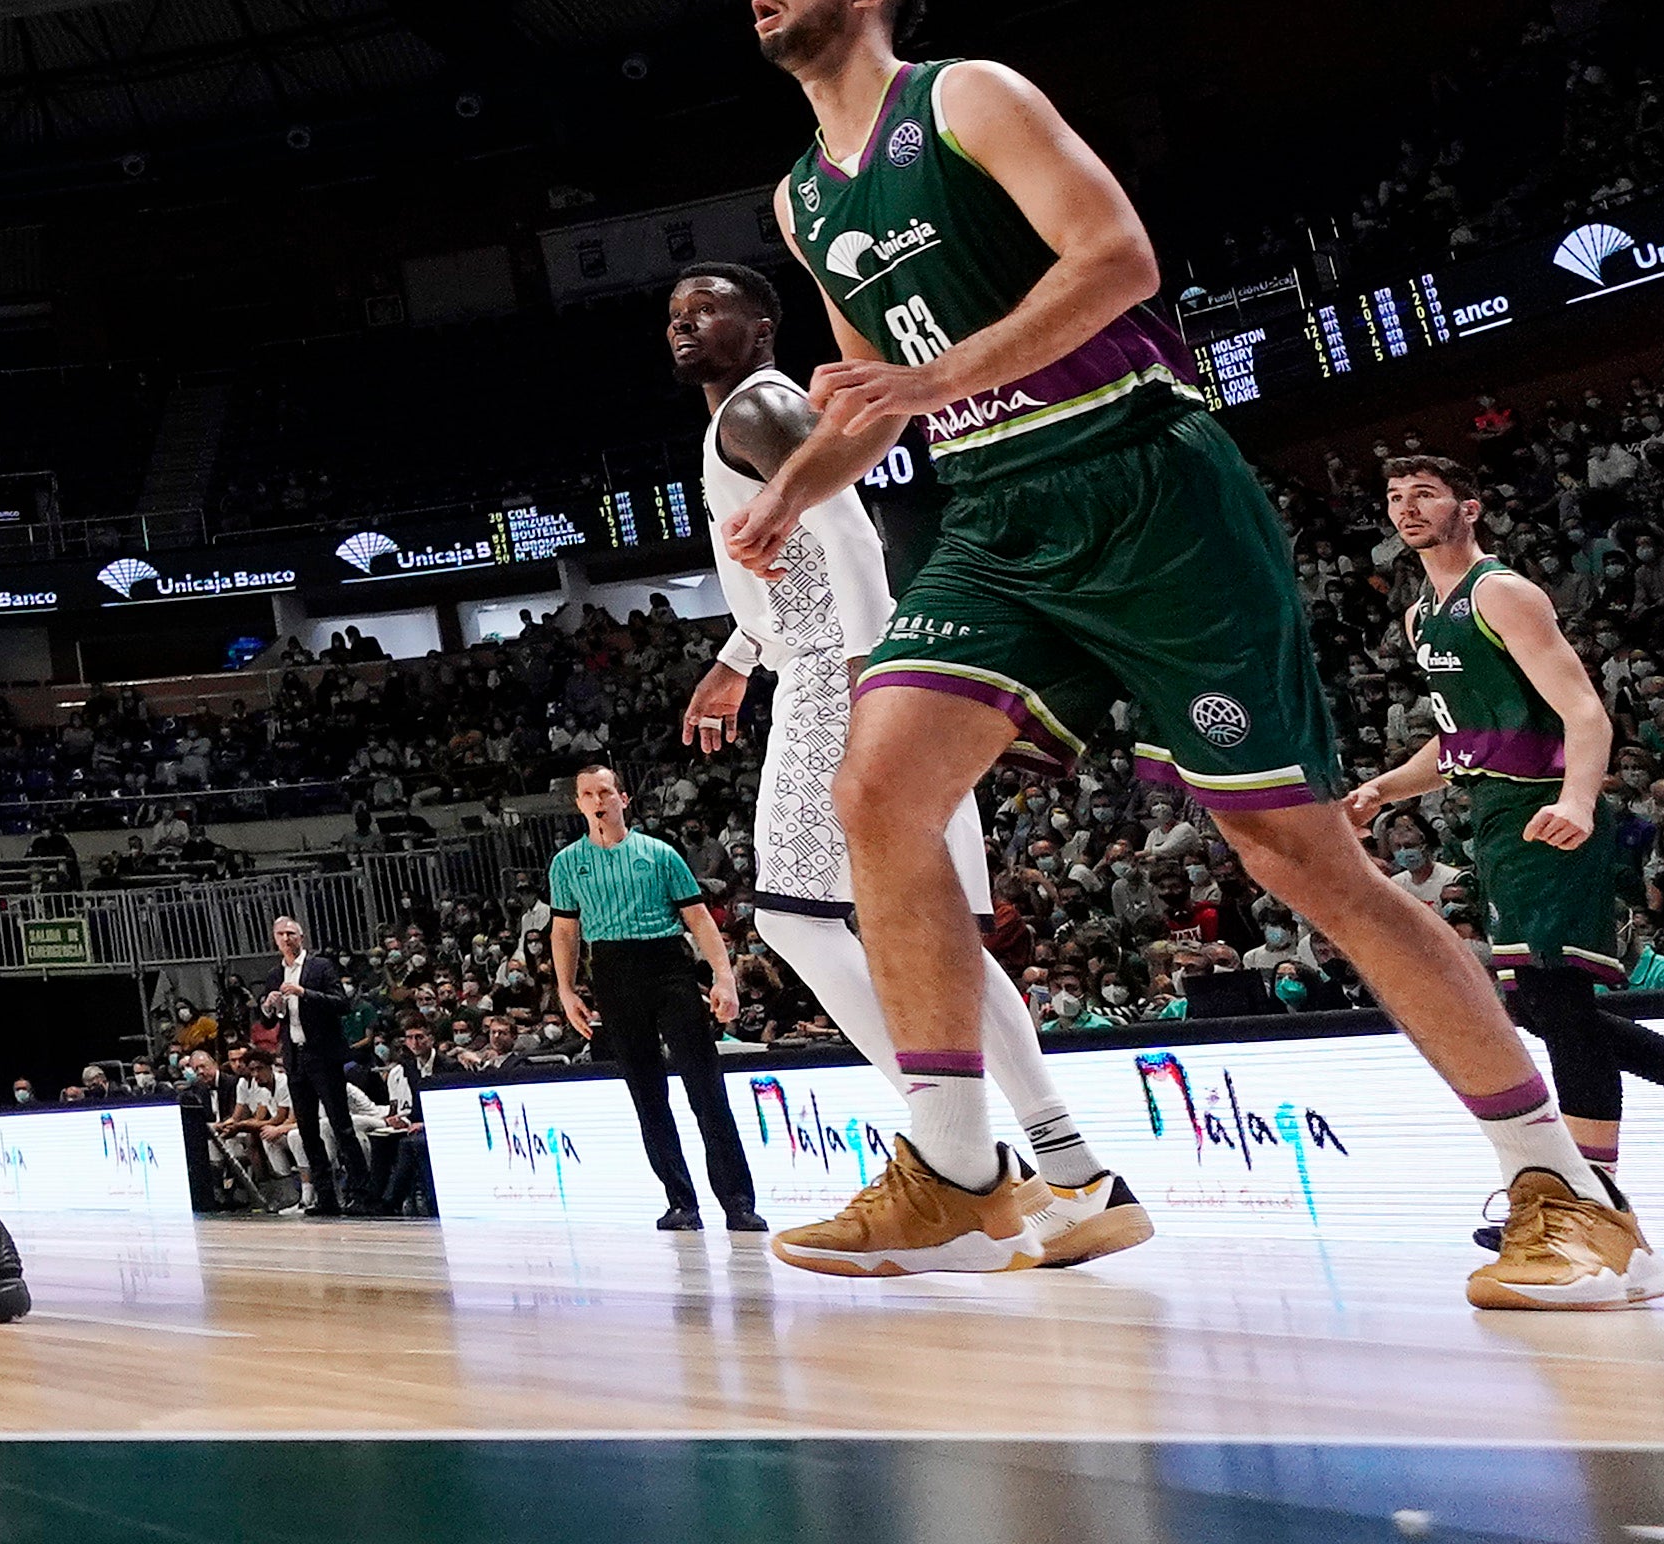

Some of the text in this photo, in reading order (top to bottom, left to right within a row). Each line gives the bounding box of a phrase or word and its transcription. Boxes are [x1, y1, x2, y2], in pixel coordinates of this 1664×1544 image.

[872, 218, 936, 261] Unicaja
[1453, 295, 1509, 326] anco
[885, 294, 955, 367] 83
[1194, 346, 1208, 360] 11
[1210, 328, 1266, 355] HOLSTON
[1197, 359, 1212, 373] 22
[1214, 345, 1254, 368] HENRY
[1304, 325, 1319, 340] 12
[1217, 359, 1255, 382] KELLY
[1203, 385, 1218, 399] 21
[1221, 375, 1256, 395] LOUM
[1207, 397, 1222, 412] 20
[1224, 386, 1261, 407] WARE
[864, 444, 914, 488] 40
[507, 506, 538, 520] COLE
[509, 513, 568, 531] BRIZUELA
[511, 522, 575, 542] BOUTEILLE
[513, 532, 586, 553] ABROMAITIS
[395, 542, 474, 570] Unicaja
[156, 567, 296, 595] Unicaja Banco
[1134, 1052, 1348, 1227] Málaga
